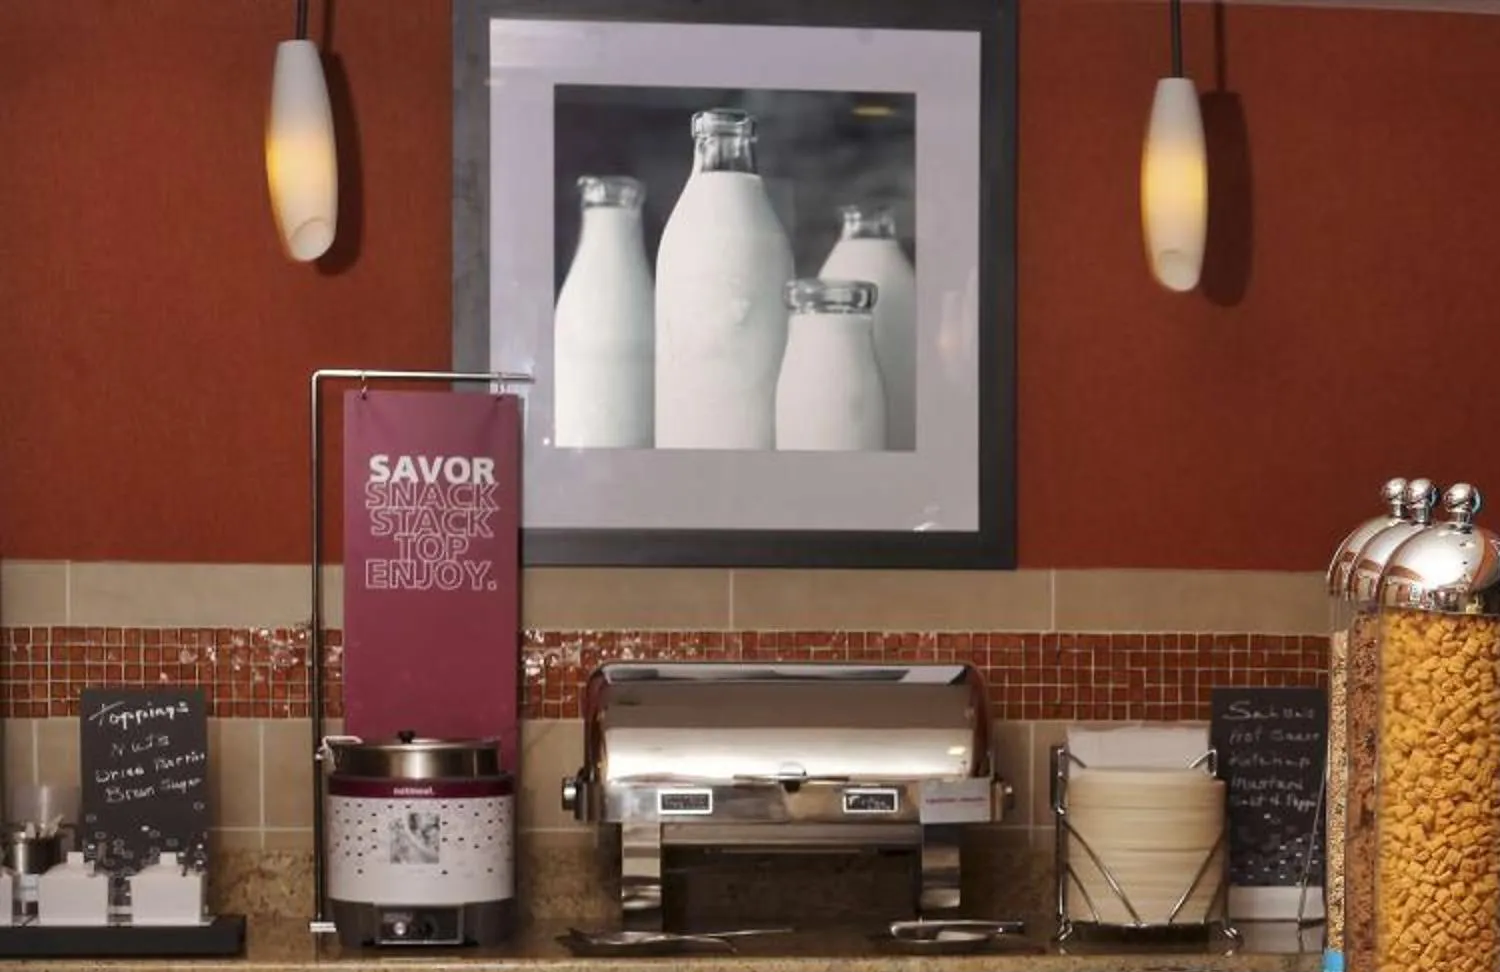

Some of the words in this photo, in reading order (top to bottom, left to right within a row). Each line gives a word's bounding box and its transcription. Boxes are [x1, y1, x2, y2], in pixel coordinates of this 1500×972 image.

[369, 454, 495, 485] SAVOR
[365, 480, 500, 512] SNACK
[370, 506, 495, 538] STACK
[394, 532, 469, 562] TOP
[365, 558, 497, 591] ENJOY.
